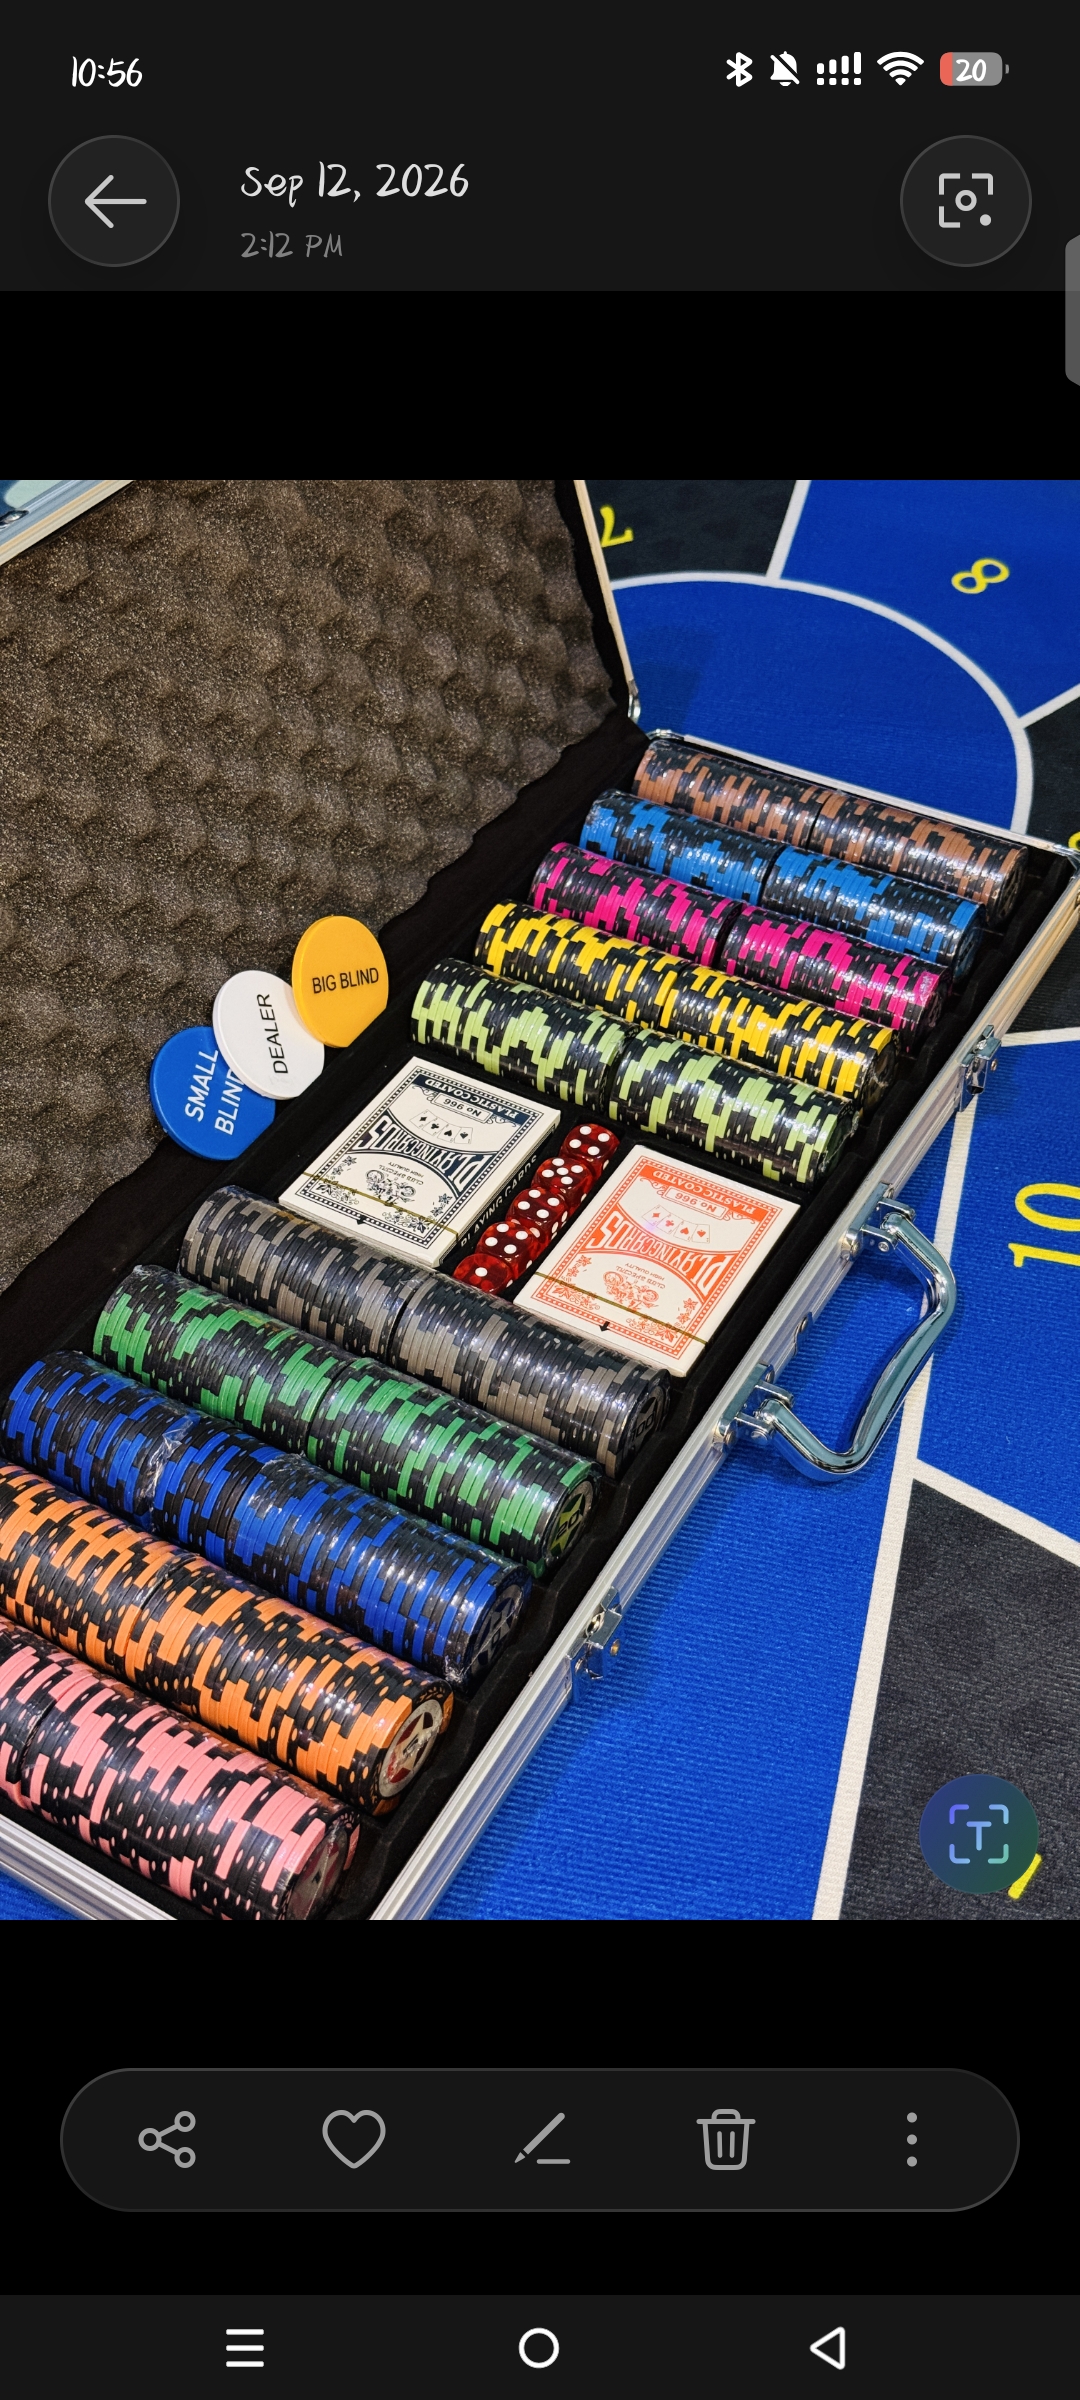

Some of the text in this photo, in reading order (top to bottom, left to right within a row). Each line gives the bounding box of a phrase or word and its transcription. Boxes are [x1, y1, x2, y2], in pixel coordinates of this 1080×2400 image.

[951, 558, 1010, 594] 8
[312, 967, 379, 994] BIG BLIND
[257, 993, 288, 1074] DEALER
[184, 1050, 218, 1122] SMALL
[443, 1098, 465, 1110] 966
[653, 1170, 756, 1215] PLASTIC COATED
[674, 1192, 697, 1205] 966
[1008, 1183, 1080, 1268] 10
[556, 1509, 579, 1541] 20
